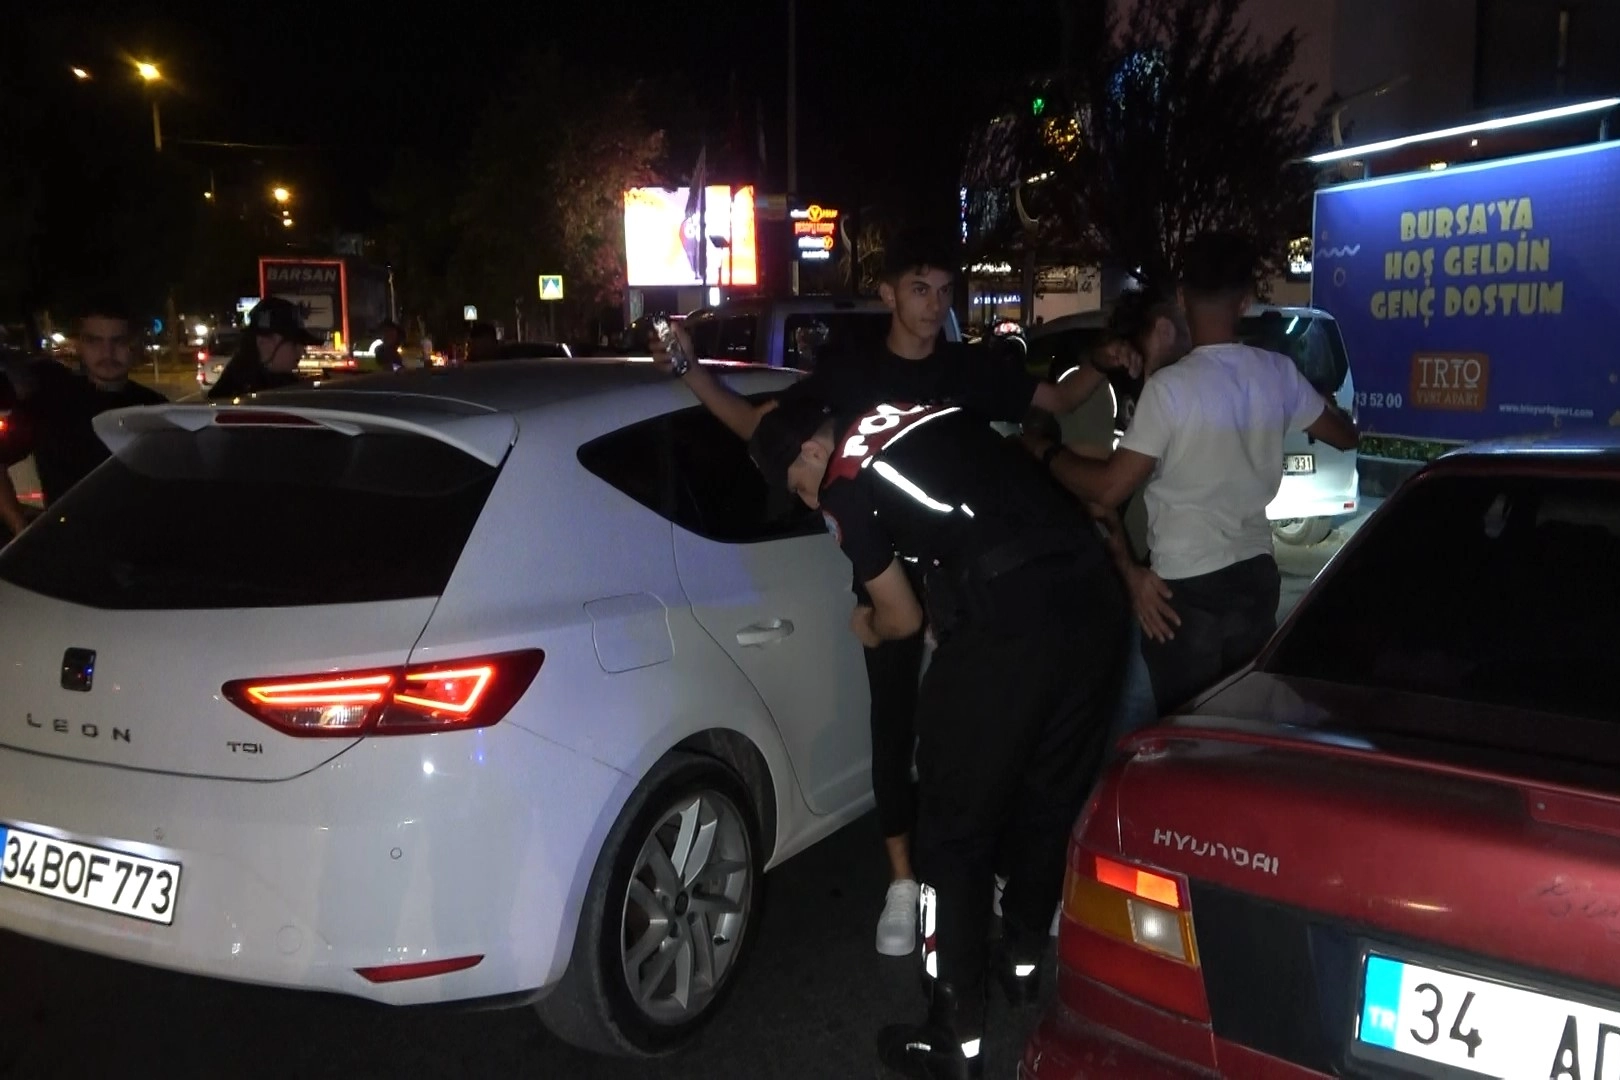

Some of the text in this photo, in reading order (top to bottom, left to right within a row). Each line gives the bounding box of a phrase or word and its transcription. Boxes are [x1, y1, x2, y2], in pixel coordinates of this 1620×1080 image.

[1400, 197, 1534, 242] BURSA'YA
[266, 266, 337, 283] BARSAN
[1384, 231, 1550, 287] HOŞ GELDİN
[1370, 281, 1564, 328] GENÇ DOSTUM
[1418, 357, 1481, 389] TRIO
[1294, 456, 1311, 470] 331
[26, 712, 131, 744] LEON
[227, 741, 264, 755] TDI
[1153, 828, 1279, 876] HYUNDAI
[1368, 1007, 1396, 1031] TR
[1410, 982, 1483, 1059] 34
